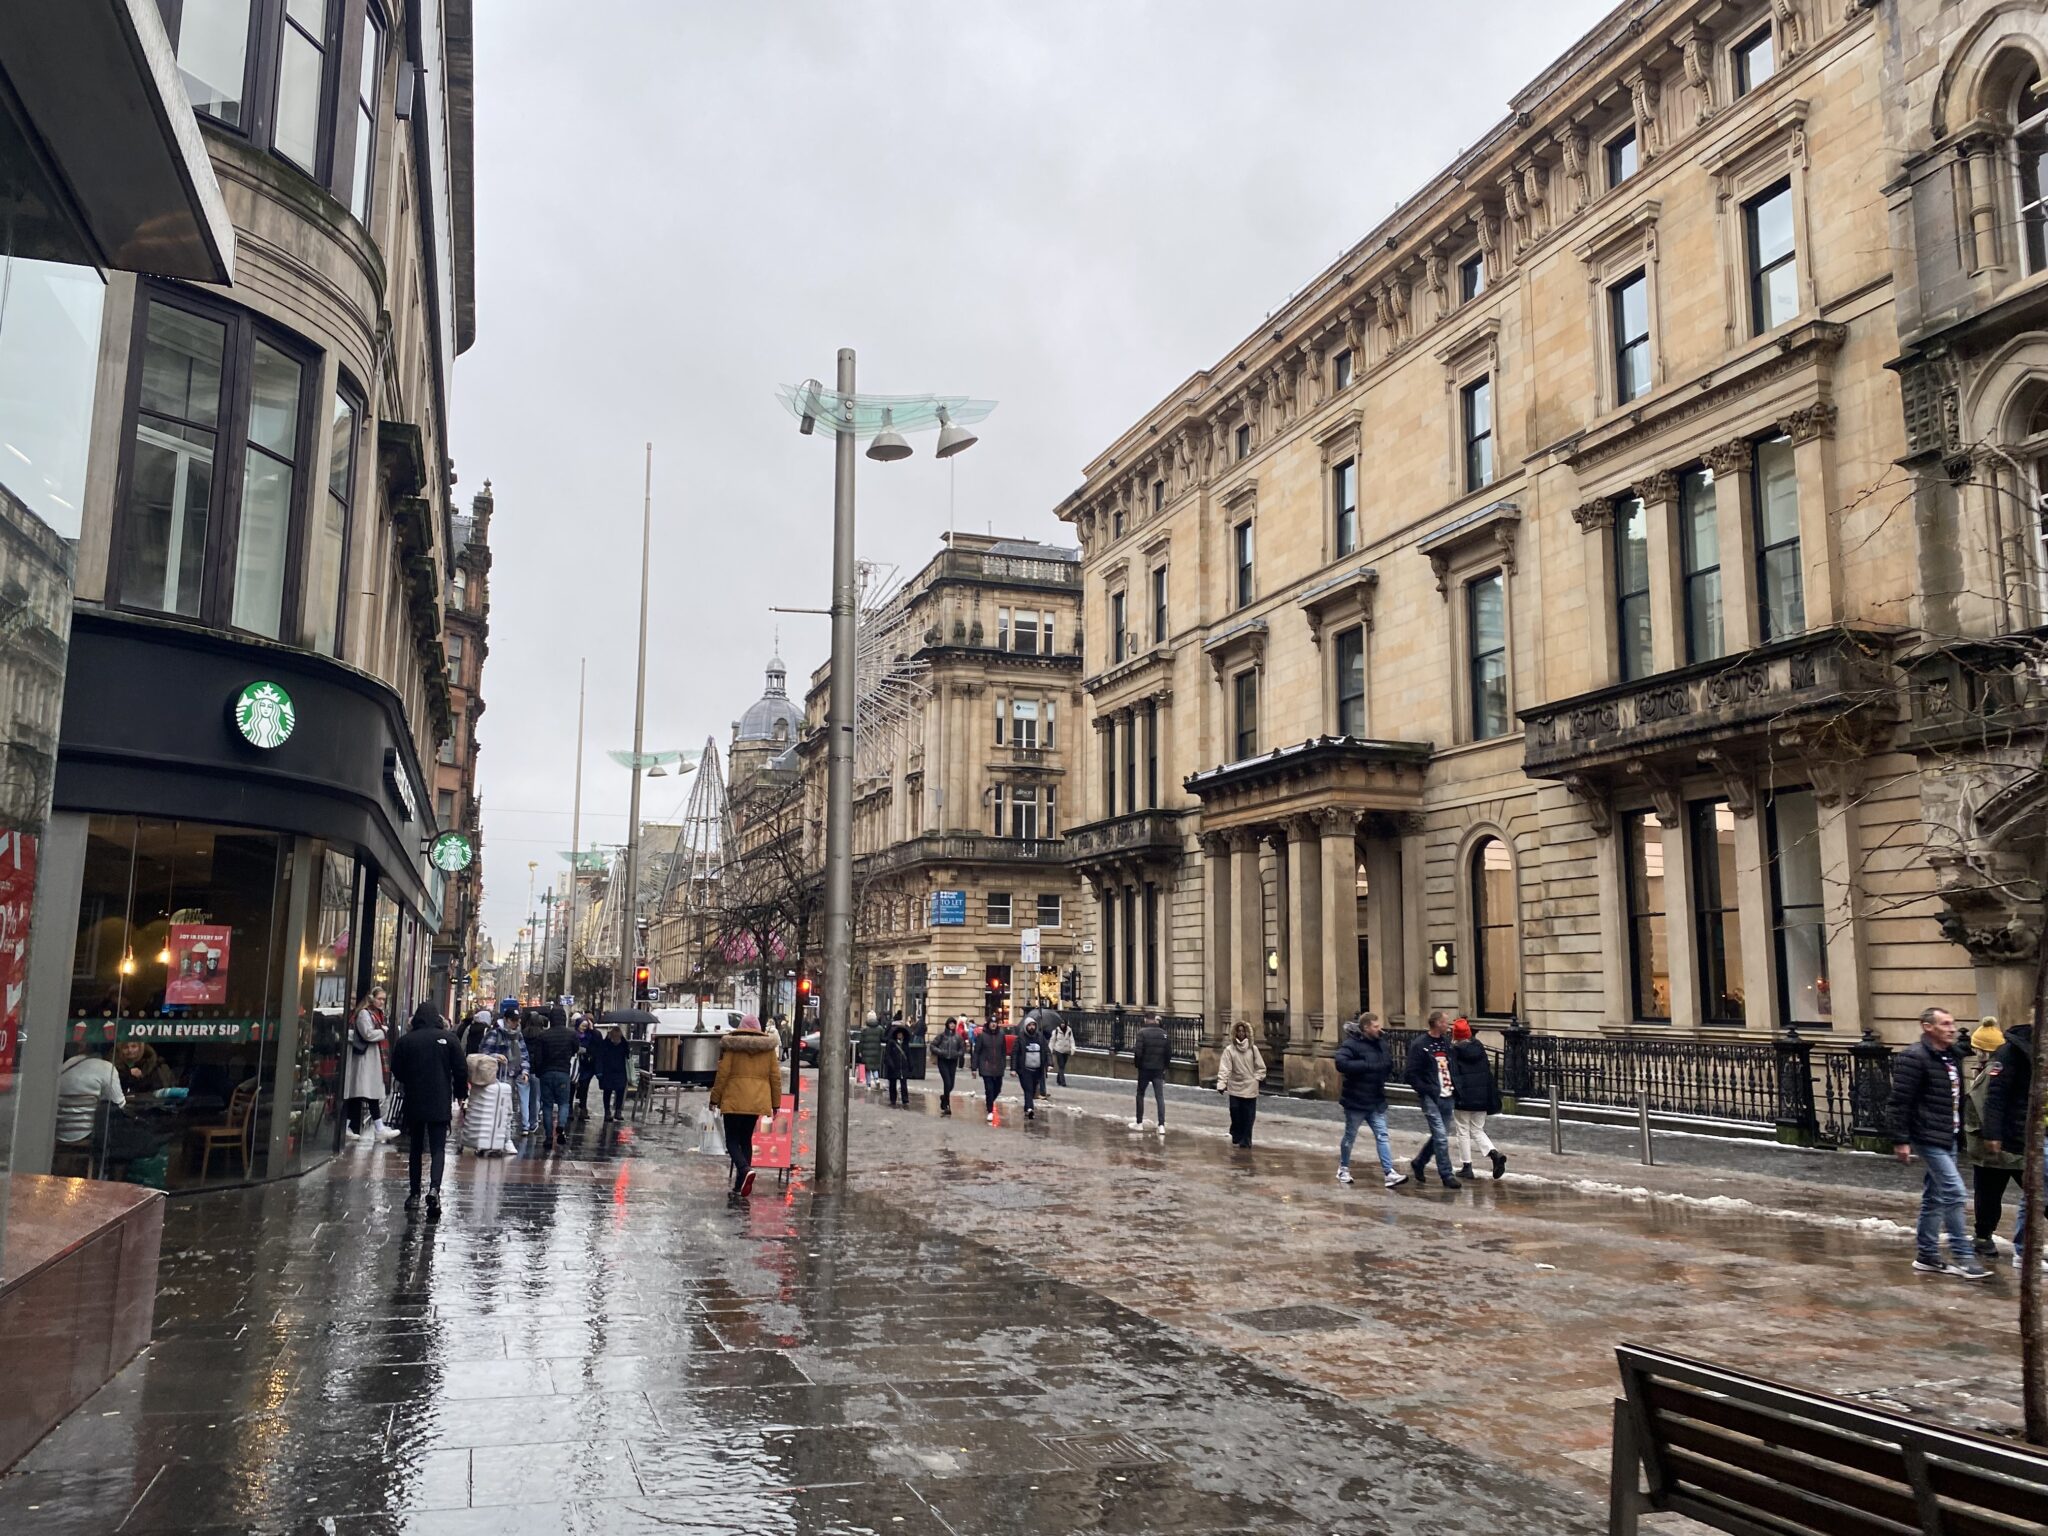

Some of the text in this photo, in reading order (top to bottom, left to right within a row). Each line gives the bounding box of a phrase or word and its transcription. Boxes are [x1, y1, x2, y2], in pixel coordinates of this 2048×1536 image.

[128, 1024, 240, 1036] JOY IN EVERY SIP
